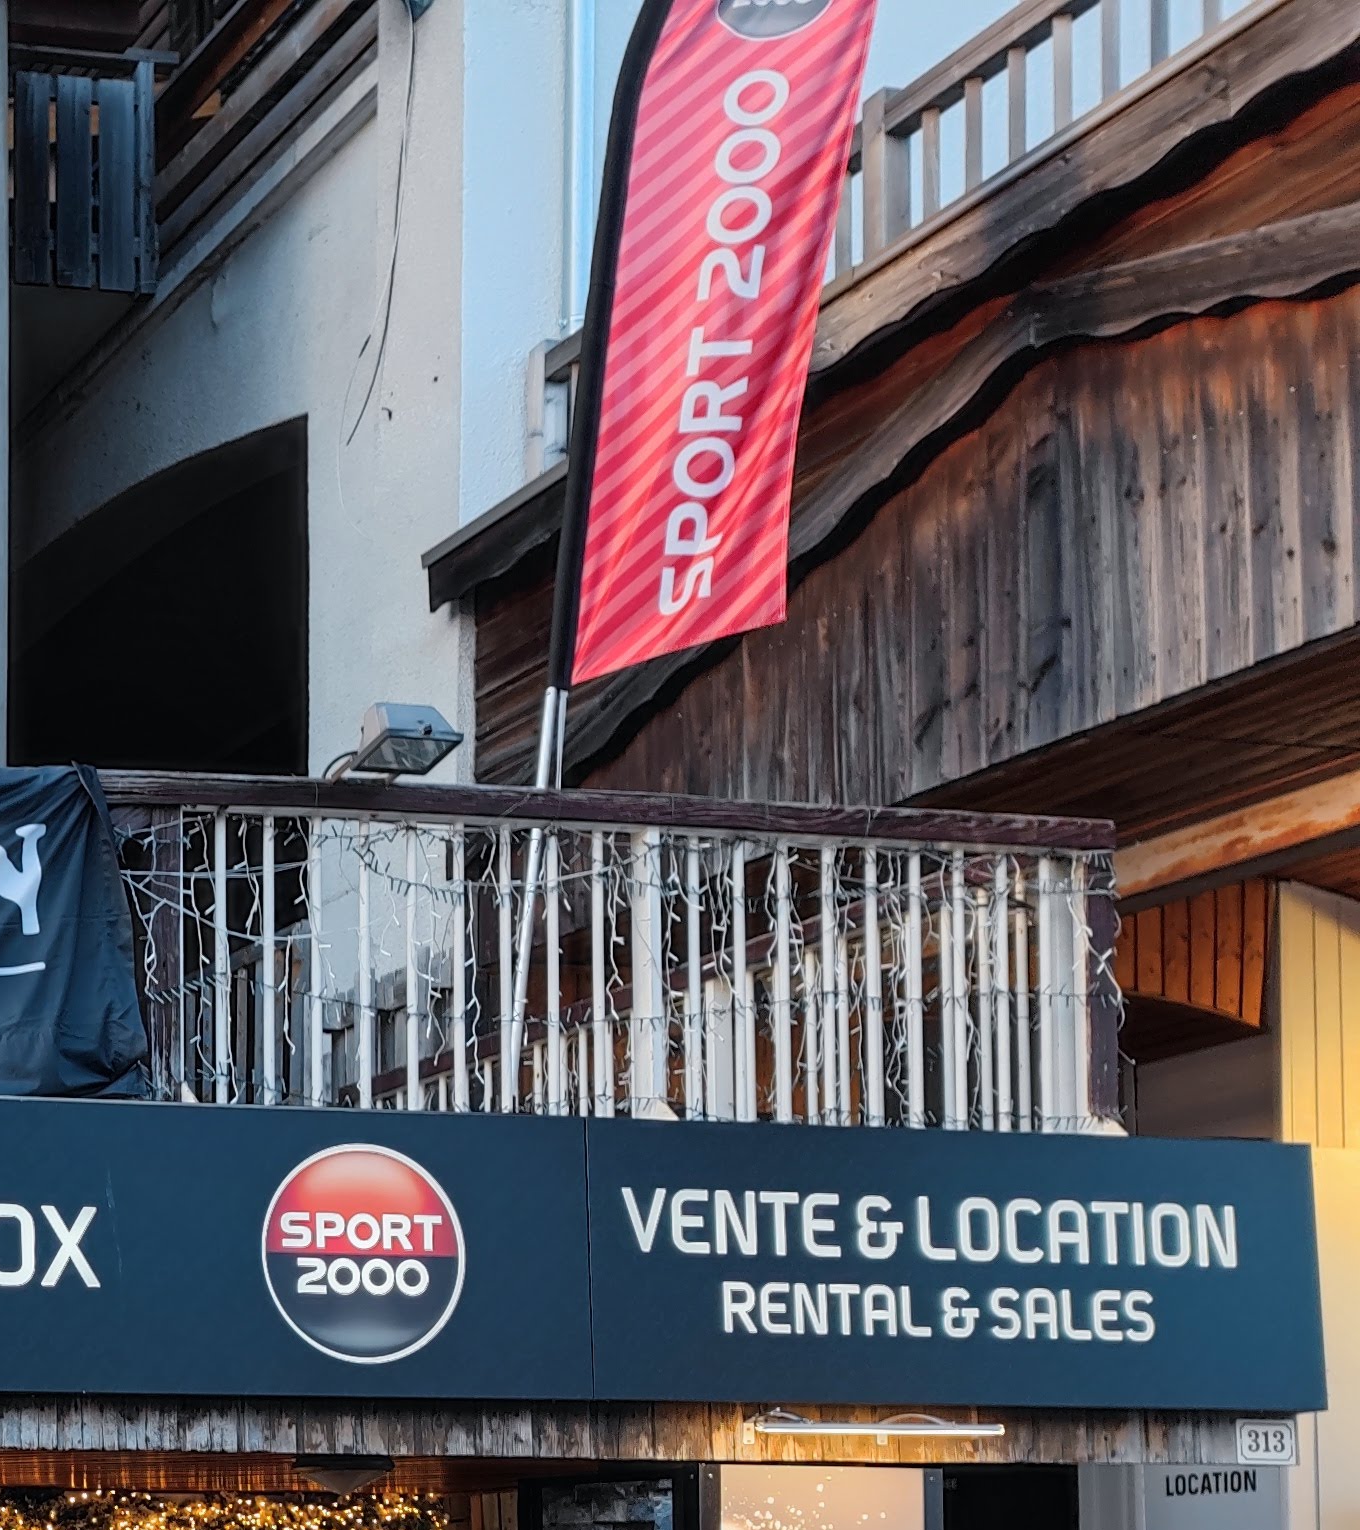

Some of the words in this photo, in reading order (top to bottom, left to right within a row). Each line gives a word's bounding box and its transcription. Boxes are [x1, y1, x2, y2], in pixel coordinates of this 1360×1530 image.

[697, 68, 791, 300] 2000
[658, 327, 755, 617] SPORT
[279, 1210, 443, 1254] SPORT
[621, 1186, 842, 1259] VENTE
[857, 1194, 905, 1261] &
[918, 1196, 1238, 1270] LOCATION
[296, 1254, 430, 1298] 2000
[721, 1279, 933, 1338] RENTAL
[942, 1286, 980, 1340] &
[990, 1286, 1156, 1343] SALES
[1246, 1429, 1286, 1454] 313
[1165, 1470, 1258, 1497] LOCATION
